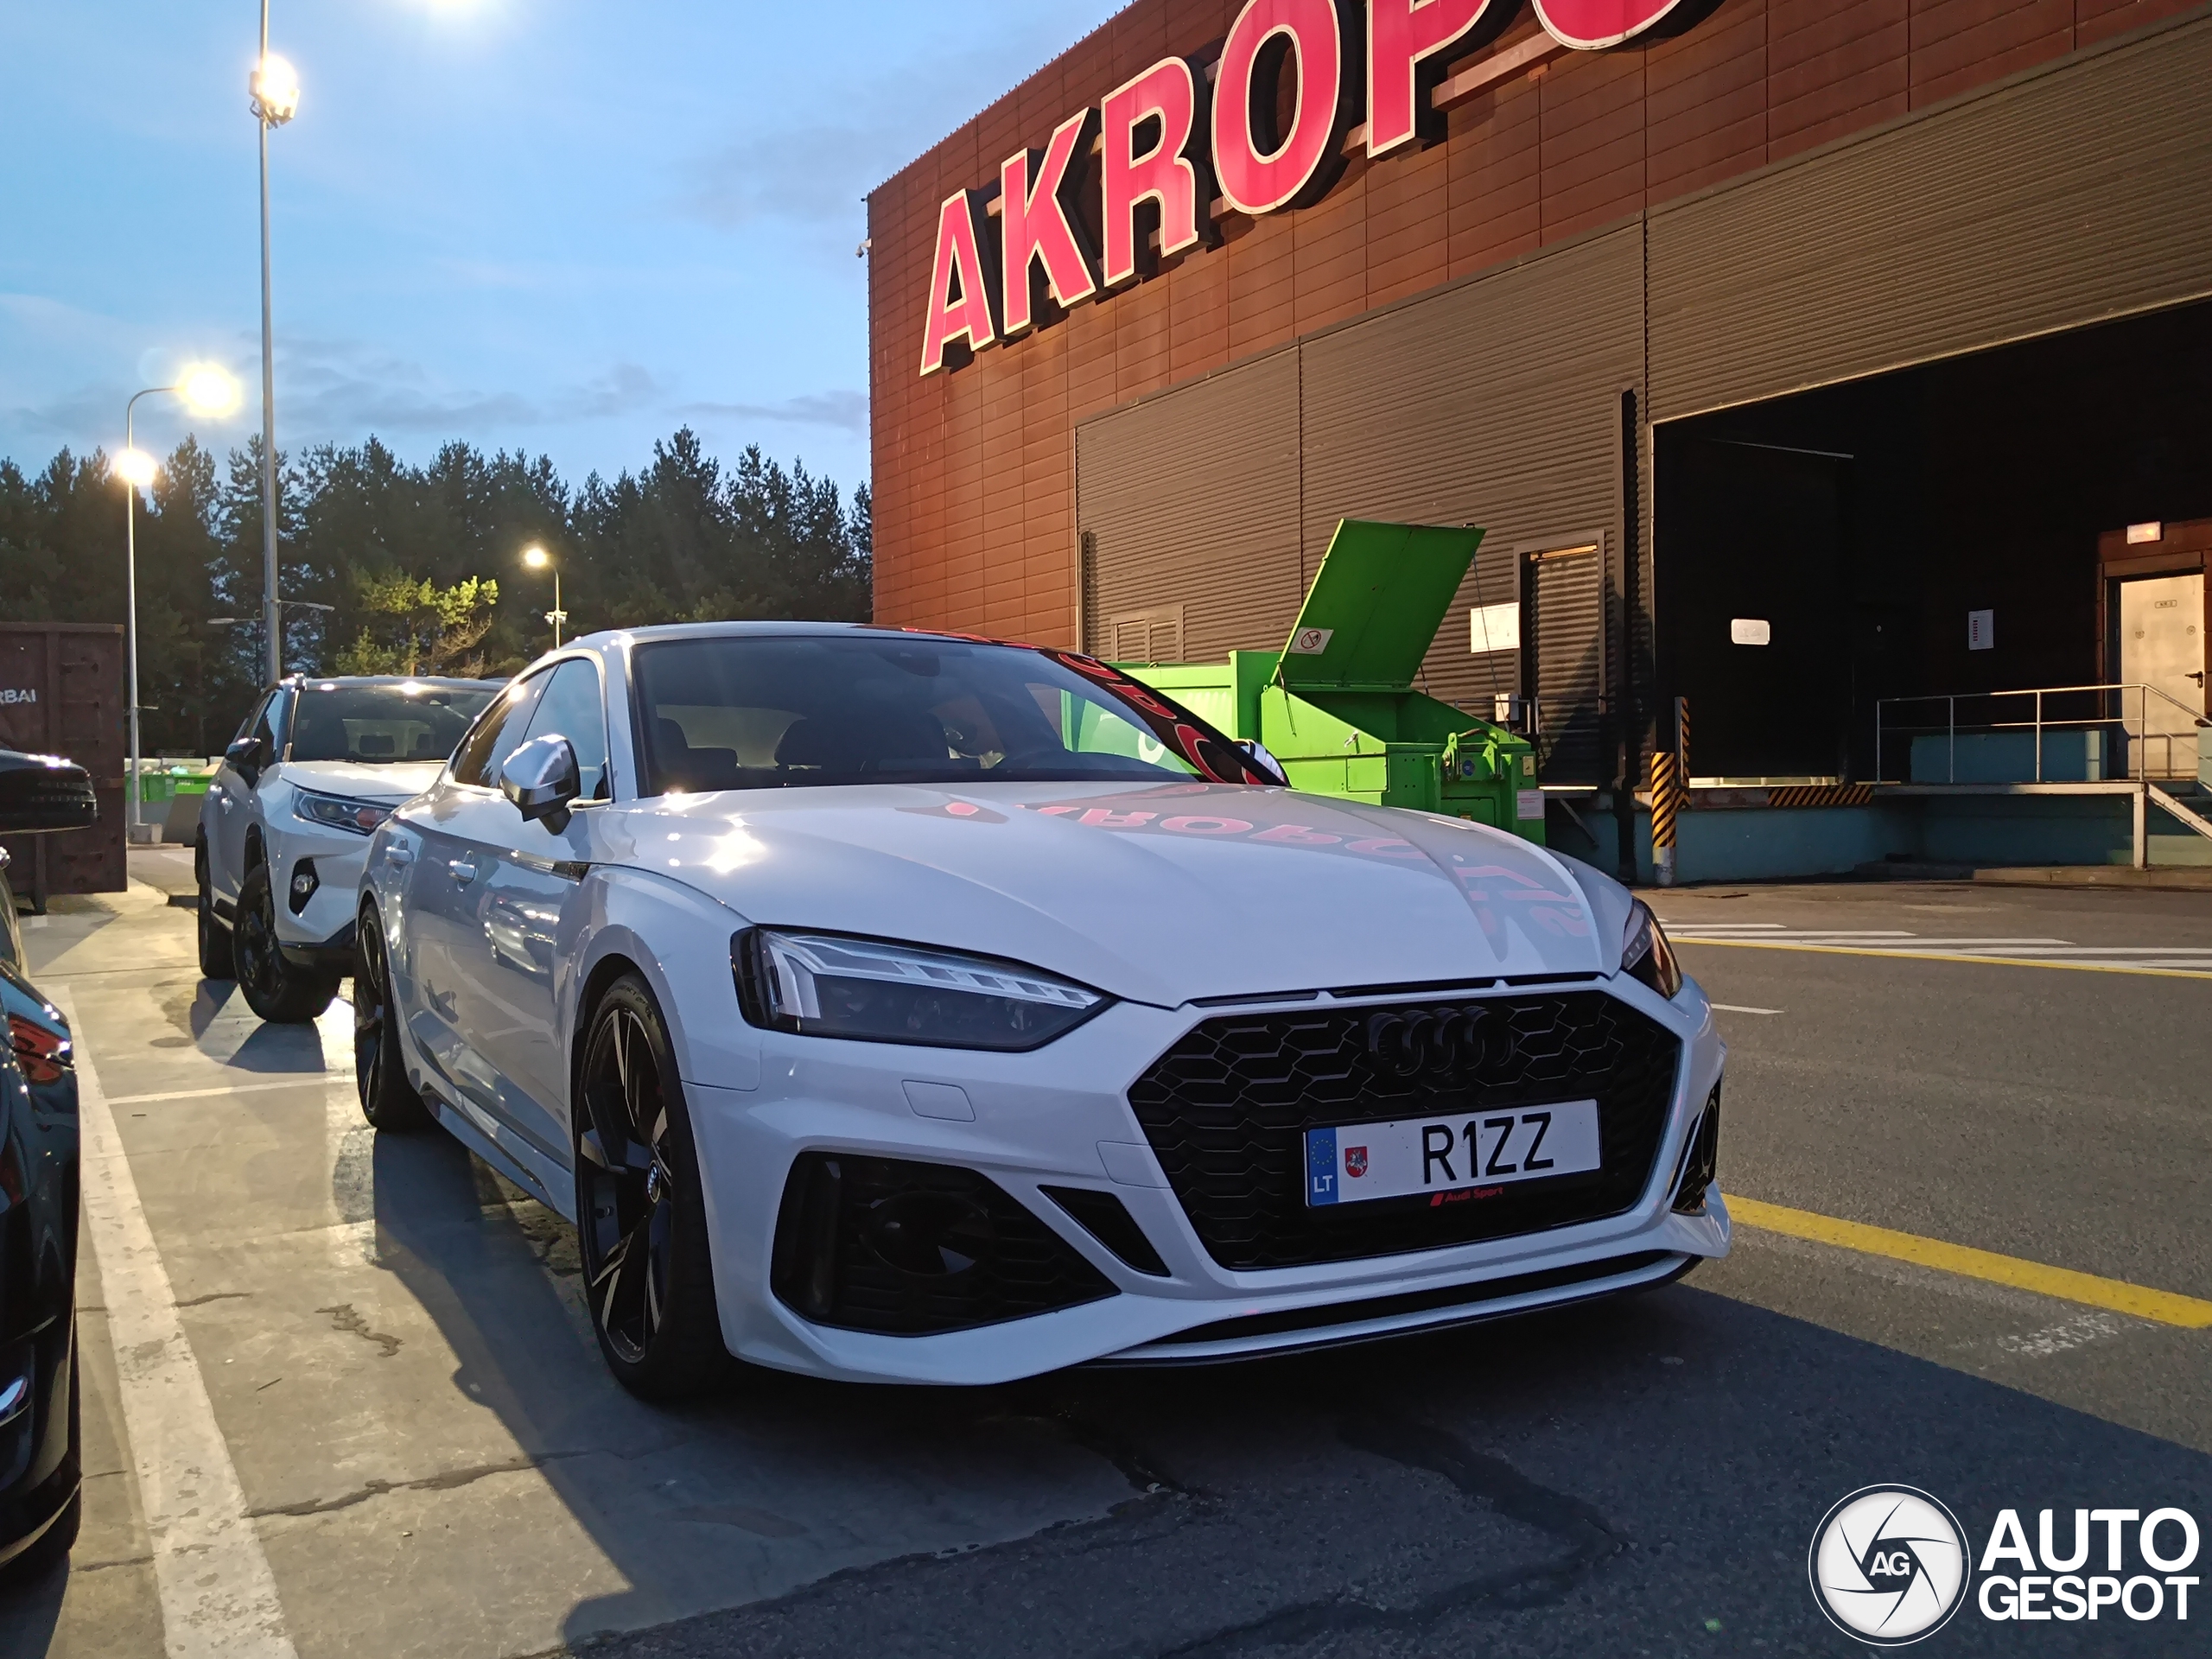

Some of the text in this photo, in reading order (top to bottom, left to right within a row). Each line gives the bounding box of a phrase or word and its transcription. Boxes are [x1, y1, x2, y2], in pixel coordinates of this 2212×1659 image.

[919, 0, 1681, 377] AKROP
[1422, 1111, 1554, 1185] R1ZZ
[1313, 1174, 1333, 1193] LT
[1445, 1186, 1503, 1202] Audi Sport
